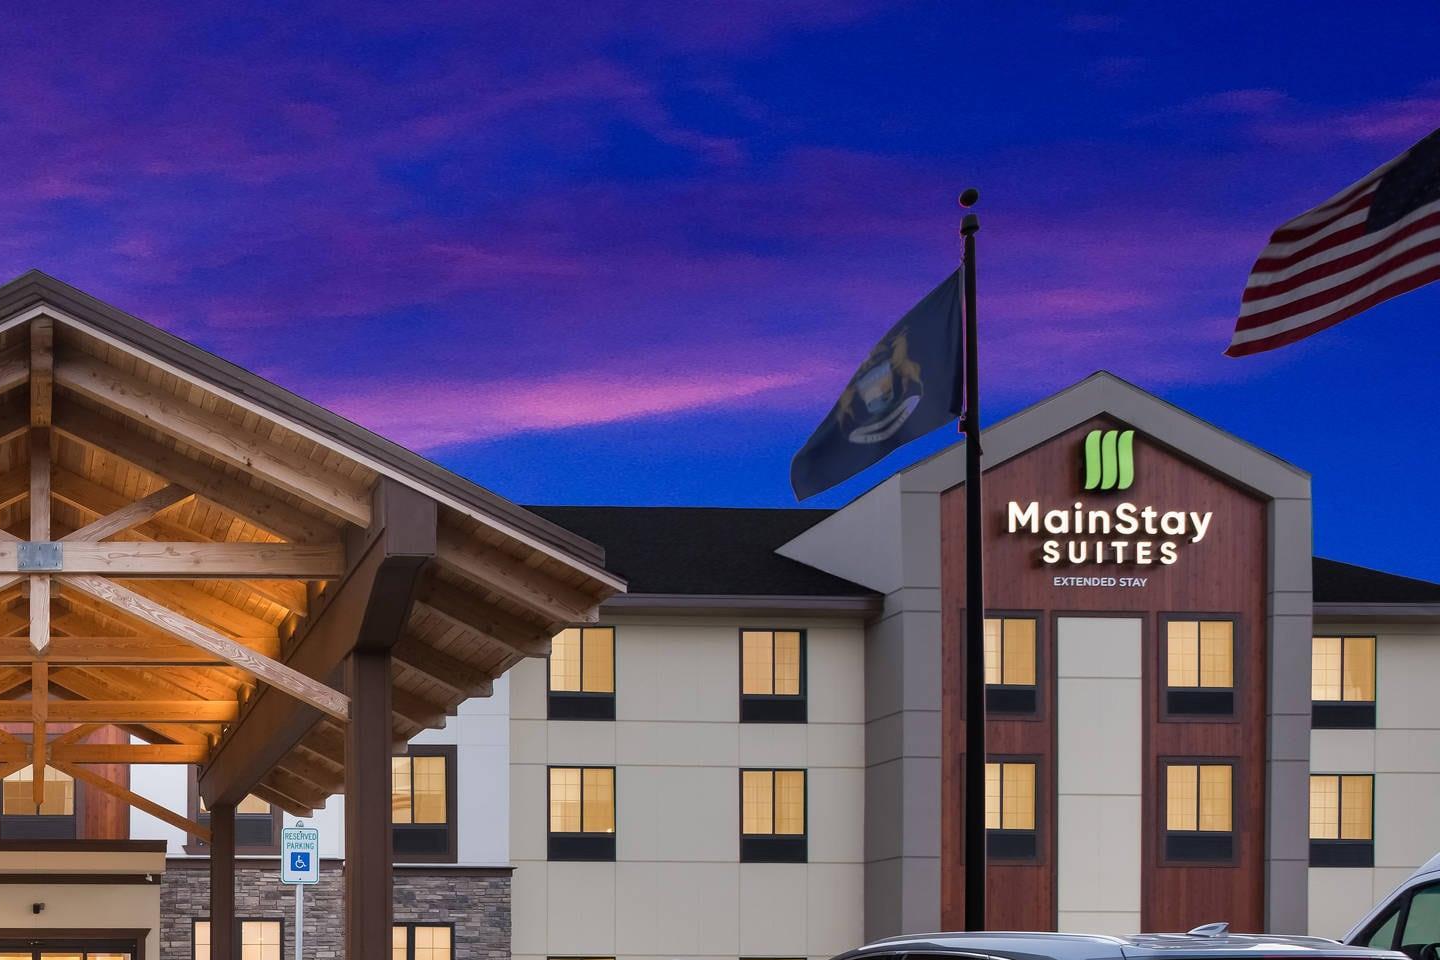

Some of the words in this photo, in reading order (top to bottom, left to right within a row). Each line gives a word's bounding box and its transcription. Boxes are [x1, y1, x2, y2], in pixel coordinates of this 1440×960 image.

[1007, 500, 1214, 544] MainStay
[1042, 540, 1179, 566] SUITES
[1053, 576, 1116, 588] EXTENDED
[1119, 577, 1148, 588] STAY
